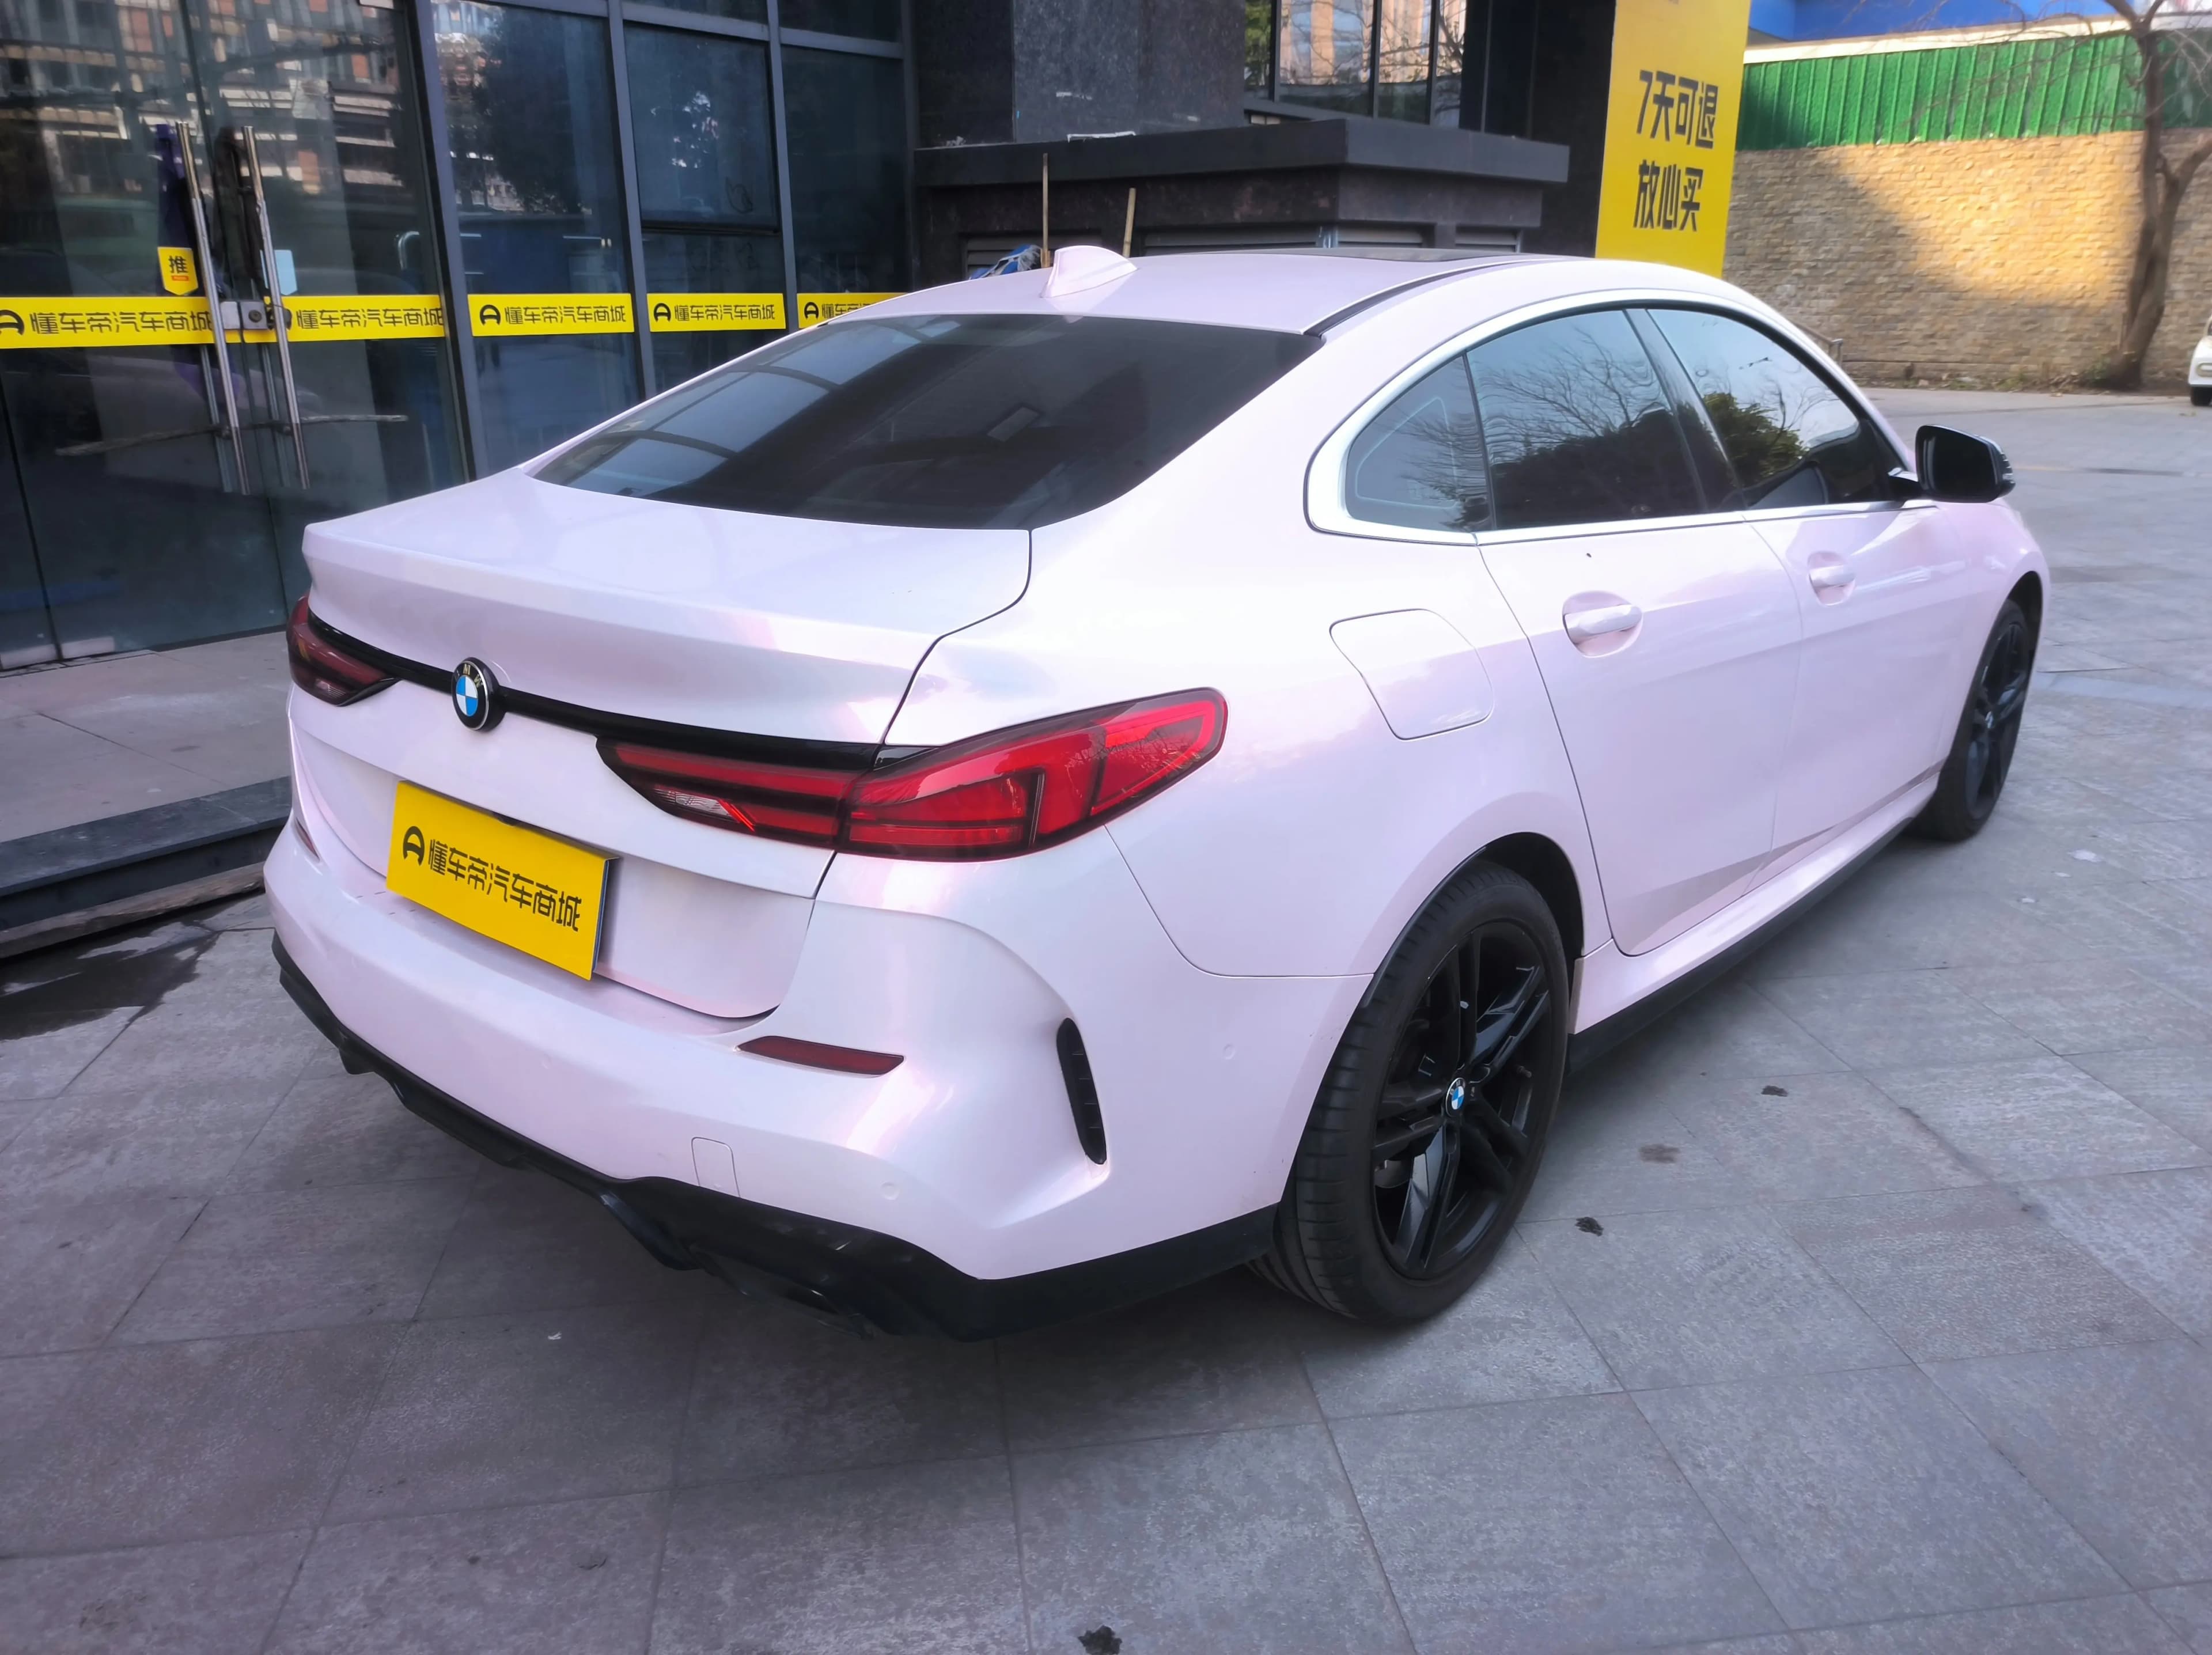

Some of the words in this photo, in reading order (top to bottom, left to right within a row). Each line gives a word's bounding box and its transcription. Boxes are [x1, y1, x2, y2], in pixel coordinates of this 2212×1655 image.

[1636, 69, 1719, 150] 7天可退
[1633, 159, 1704, 232] 放心买
[168, 255, 189, 274] 推
[29, 311, 213, 335] 懂车帝汽车商城
[296, 308, 444, 329] 懂车帝汽车商城
[504, 305, 627, 324] 懂车帝汽车商城
[674, 304, 775, 321] 懂车帝汽车商城
[427, 839, 582, 931] 懂车帝汽车商城
